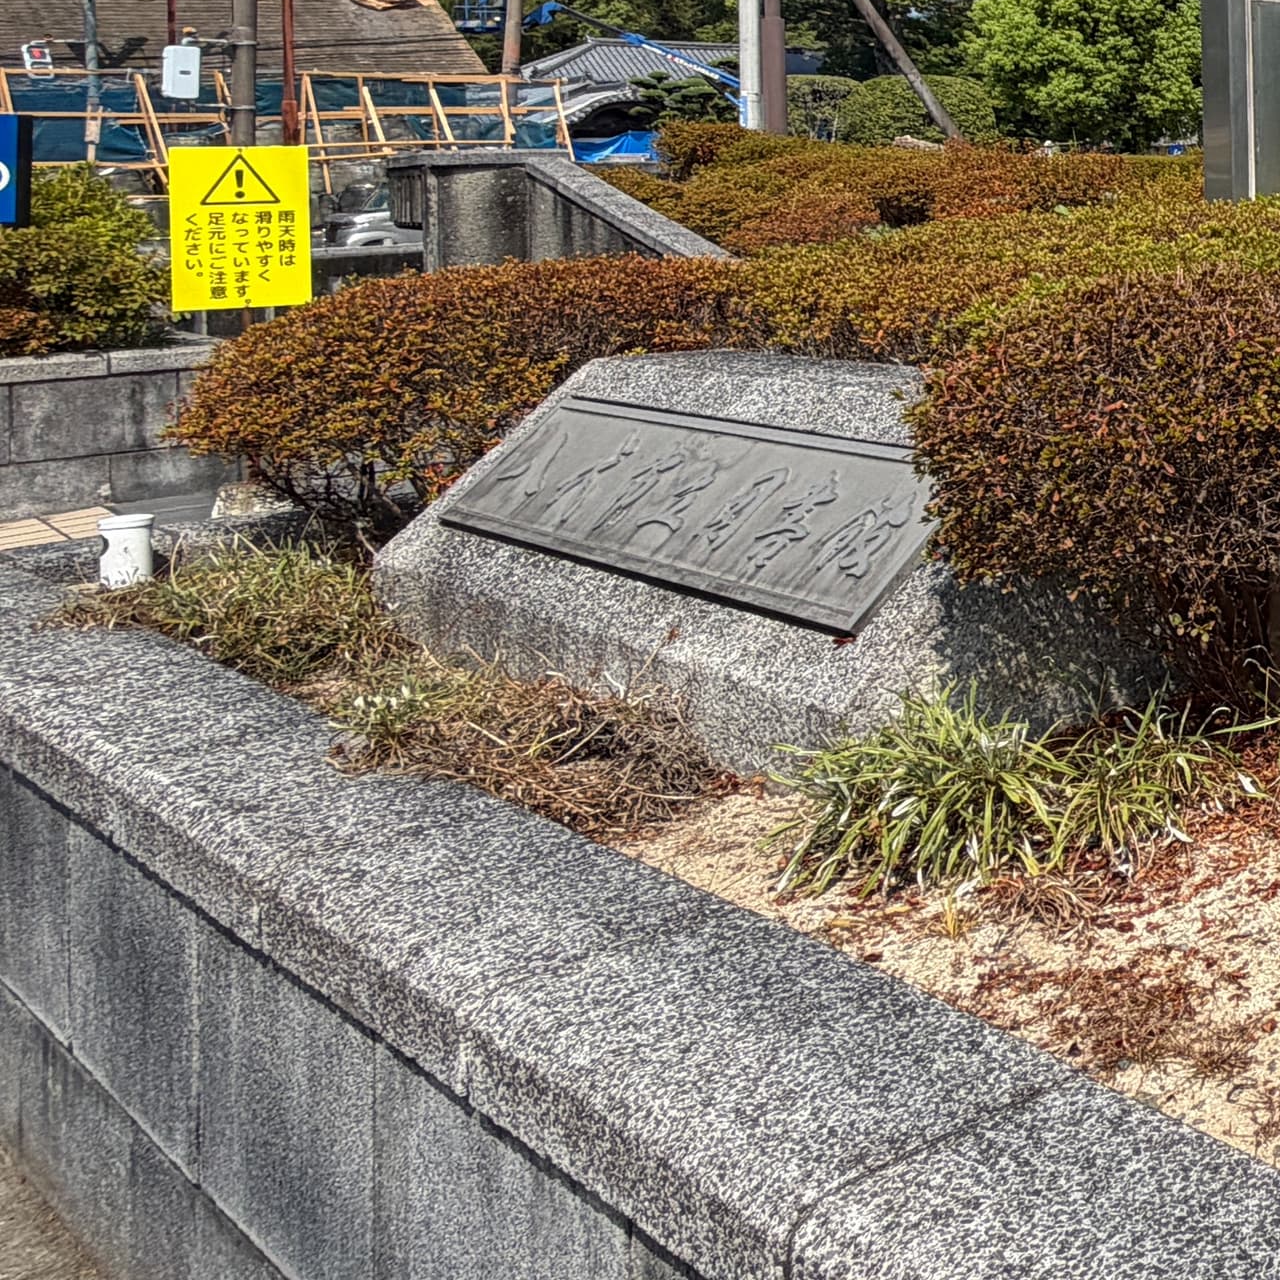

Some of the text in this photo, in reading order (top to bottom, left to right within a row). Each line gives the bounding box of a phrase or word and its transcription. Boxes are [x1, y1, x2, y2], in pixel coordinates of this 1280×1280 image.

[184, 213, 204, 277] ください。
[208, 212, 228, 299] 足元にご注意
[231, 212, 252, 304] なっています。
[255, 211, 274, 282] 滑りやすく
[277, 210, 296, 266] 雨天時は
